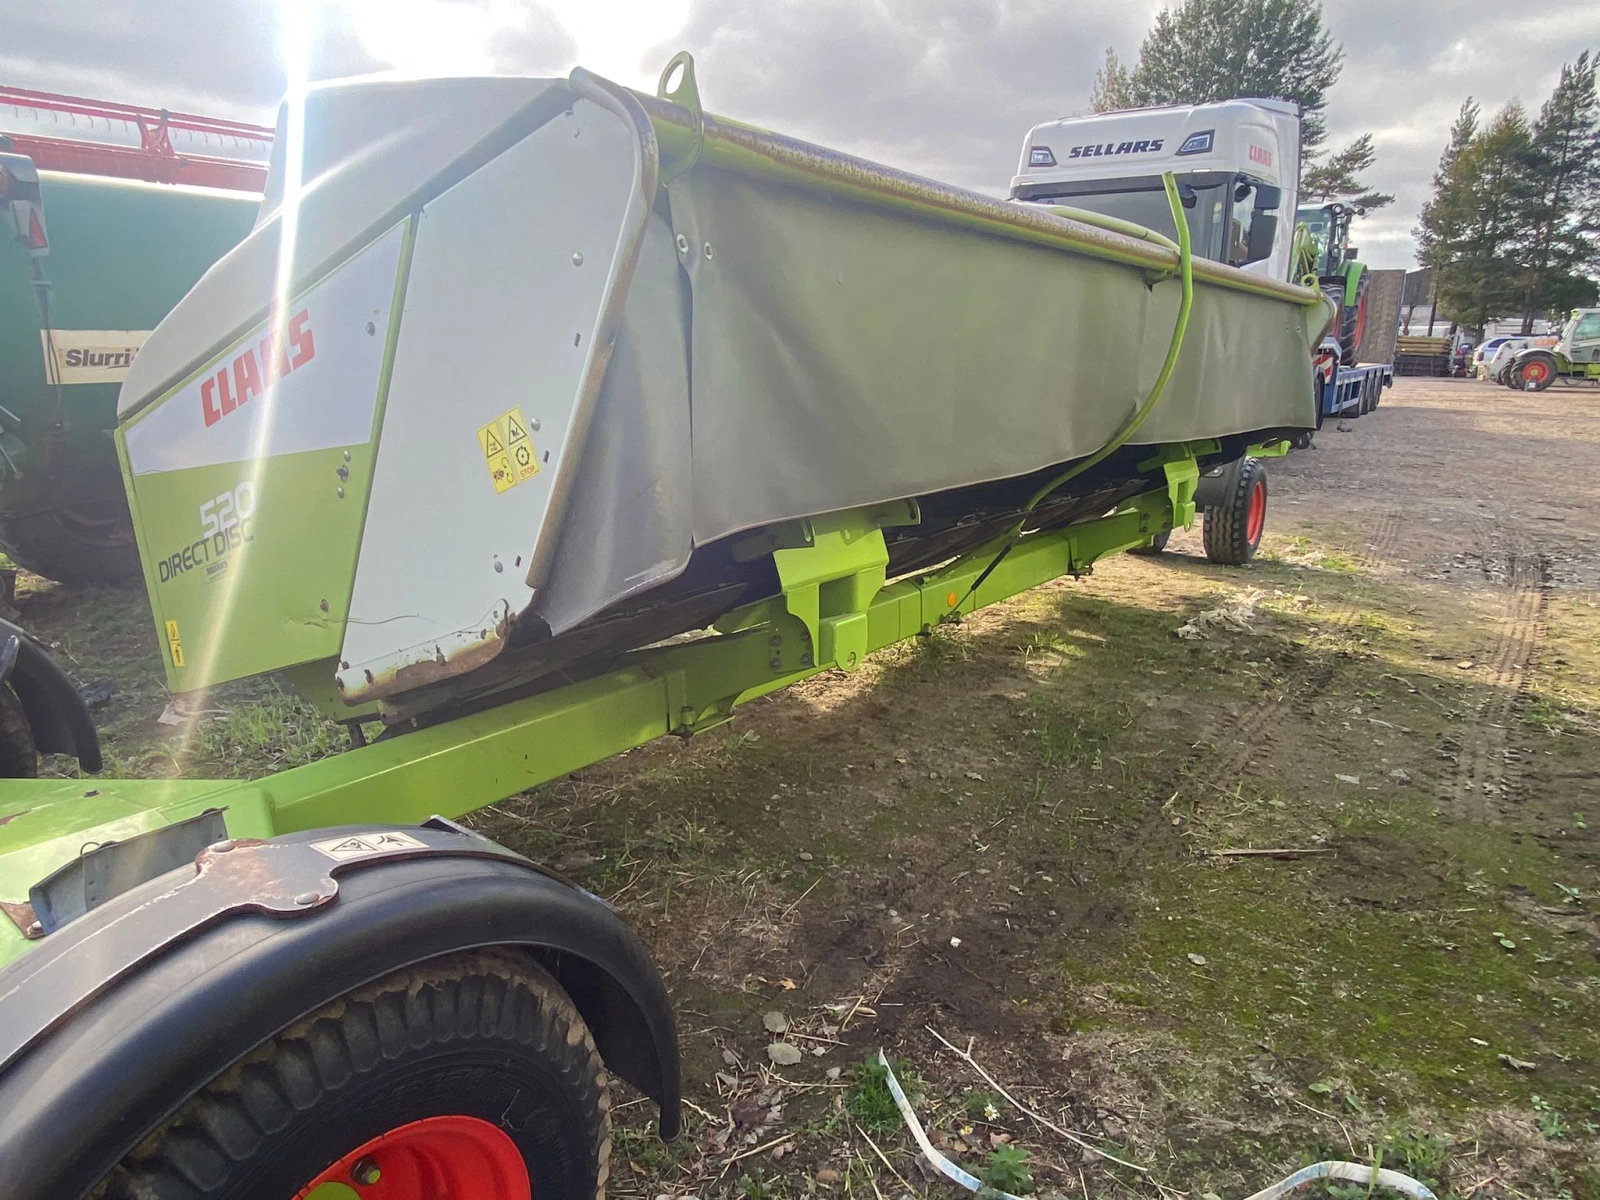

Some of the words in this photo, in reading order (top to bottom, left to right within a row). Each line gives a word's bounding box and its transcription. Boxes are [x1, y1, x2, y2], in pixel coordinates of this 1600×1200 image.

[1069, 139, 1164, 158] SELLARS
[200, 308, 315, 428] CLAAS
[520, 465, 535, 477] STOP
[200, 480, 256, 539] 520
[158, 537, 210, 583] DIRECT
[213, 516, 254, 557] DISC
